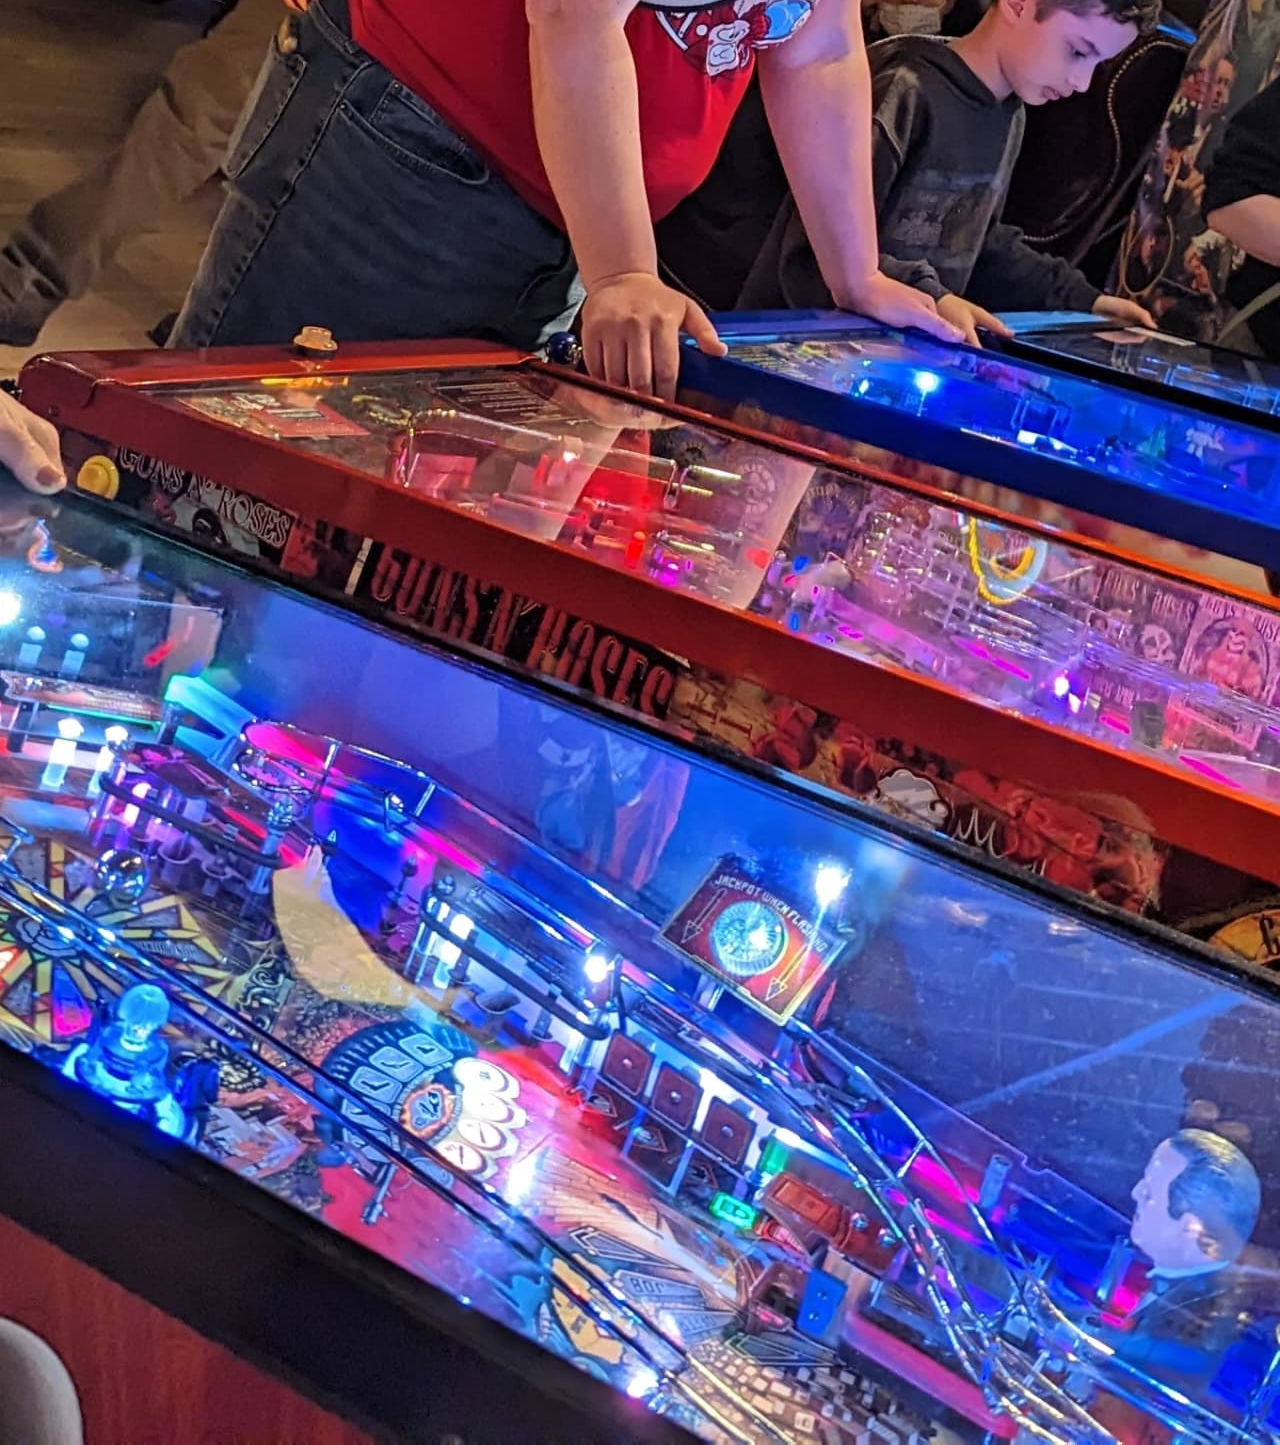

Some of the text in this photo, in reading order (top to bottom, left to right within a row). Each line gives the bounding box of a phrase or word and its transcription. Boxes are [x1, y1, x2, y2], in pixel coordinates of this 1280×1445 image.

[118, 445, 186, 493] GUNS
[219, 485, 292, 549] ROSES
[371, 544, 480, 643] GUNS
[526, 604, 675, 720] ROSES
[713, 874, 761, 898] JACKPOT
[761, 890, 791, 918] WHEN
